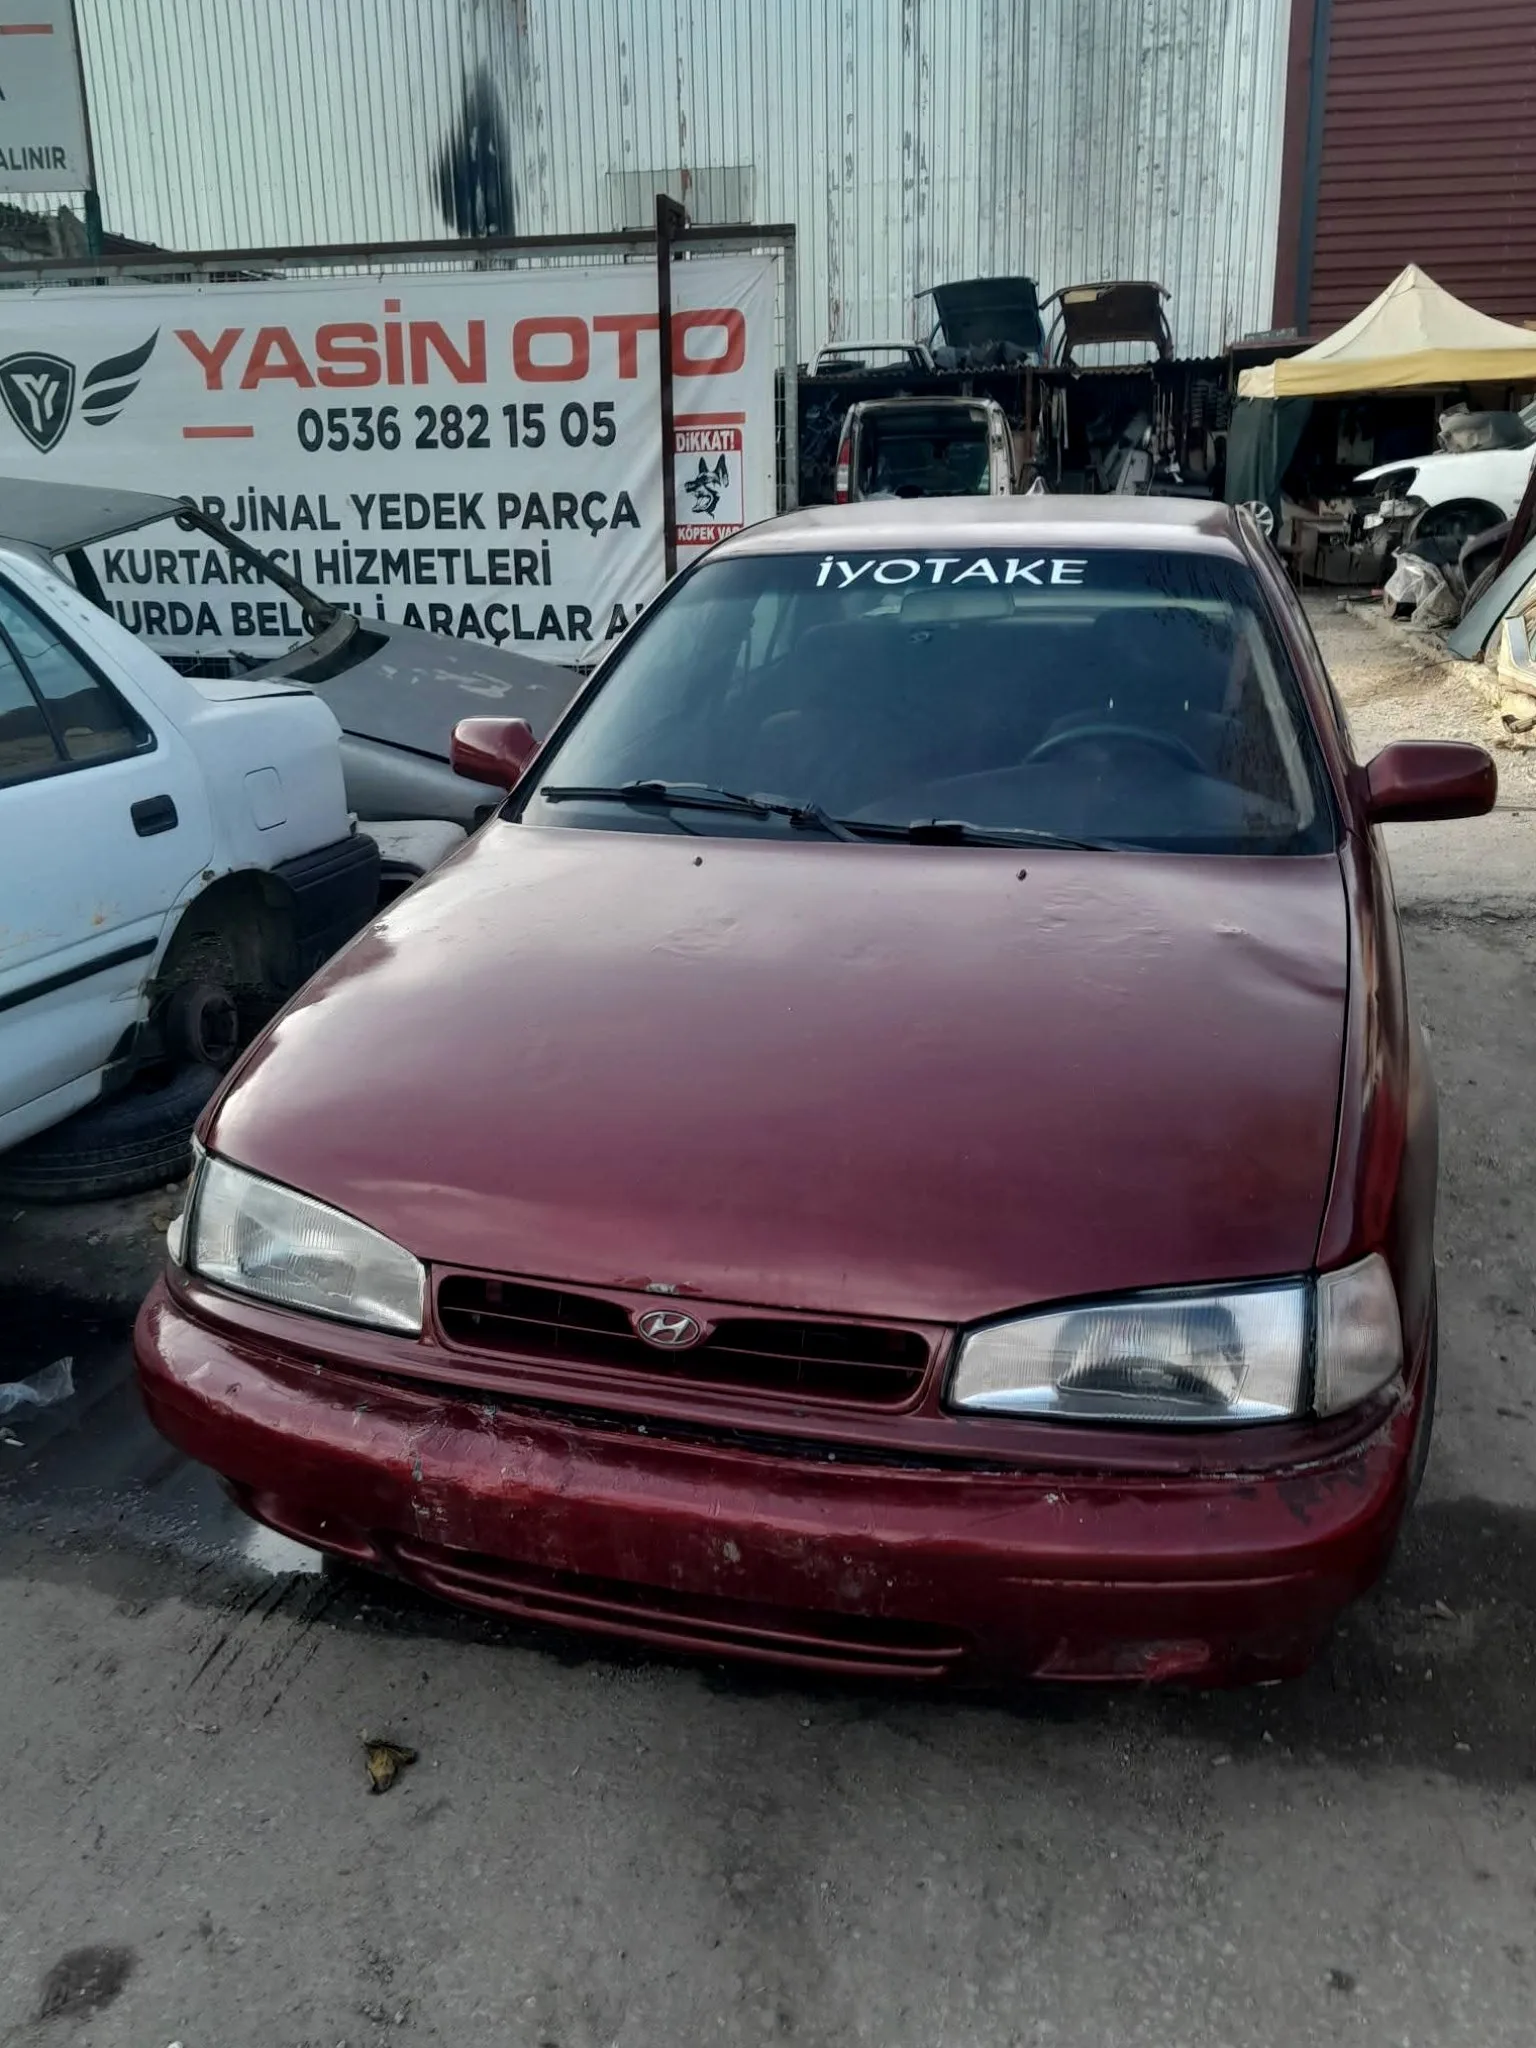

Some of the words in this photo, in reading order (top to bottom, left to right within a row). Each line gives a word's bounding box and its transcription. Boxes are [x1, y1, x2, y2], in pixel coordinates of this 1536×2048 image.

[173, 299, 487, 390] YASİN
[513, 308, 746, 382] OTO
[297, 405, 401, 452] 0536
[415, 404, 490, 449] 282
[503, 403, 546, 448] 15
[560, 401, 617, 447] 05
[350, 492, 486, 530] YEDEK
[499, 490, 641, 537] PARÇA
[677, 525, 715, 541] KÖPEK
[314, 539, 552, 586] HİZMETLERİ
[402, 603, 593, 646] ARAÇLAR
[604, 603, 644, 640] A
